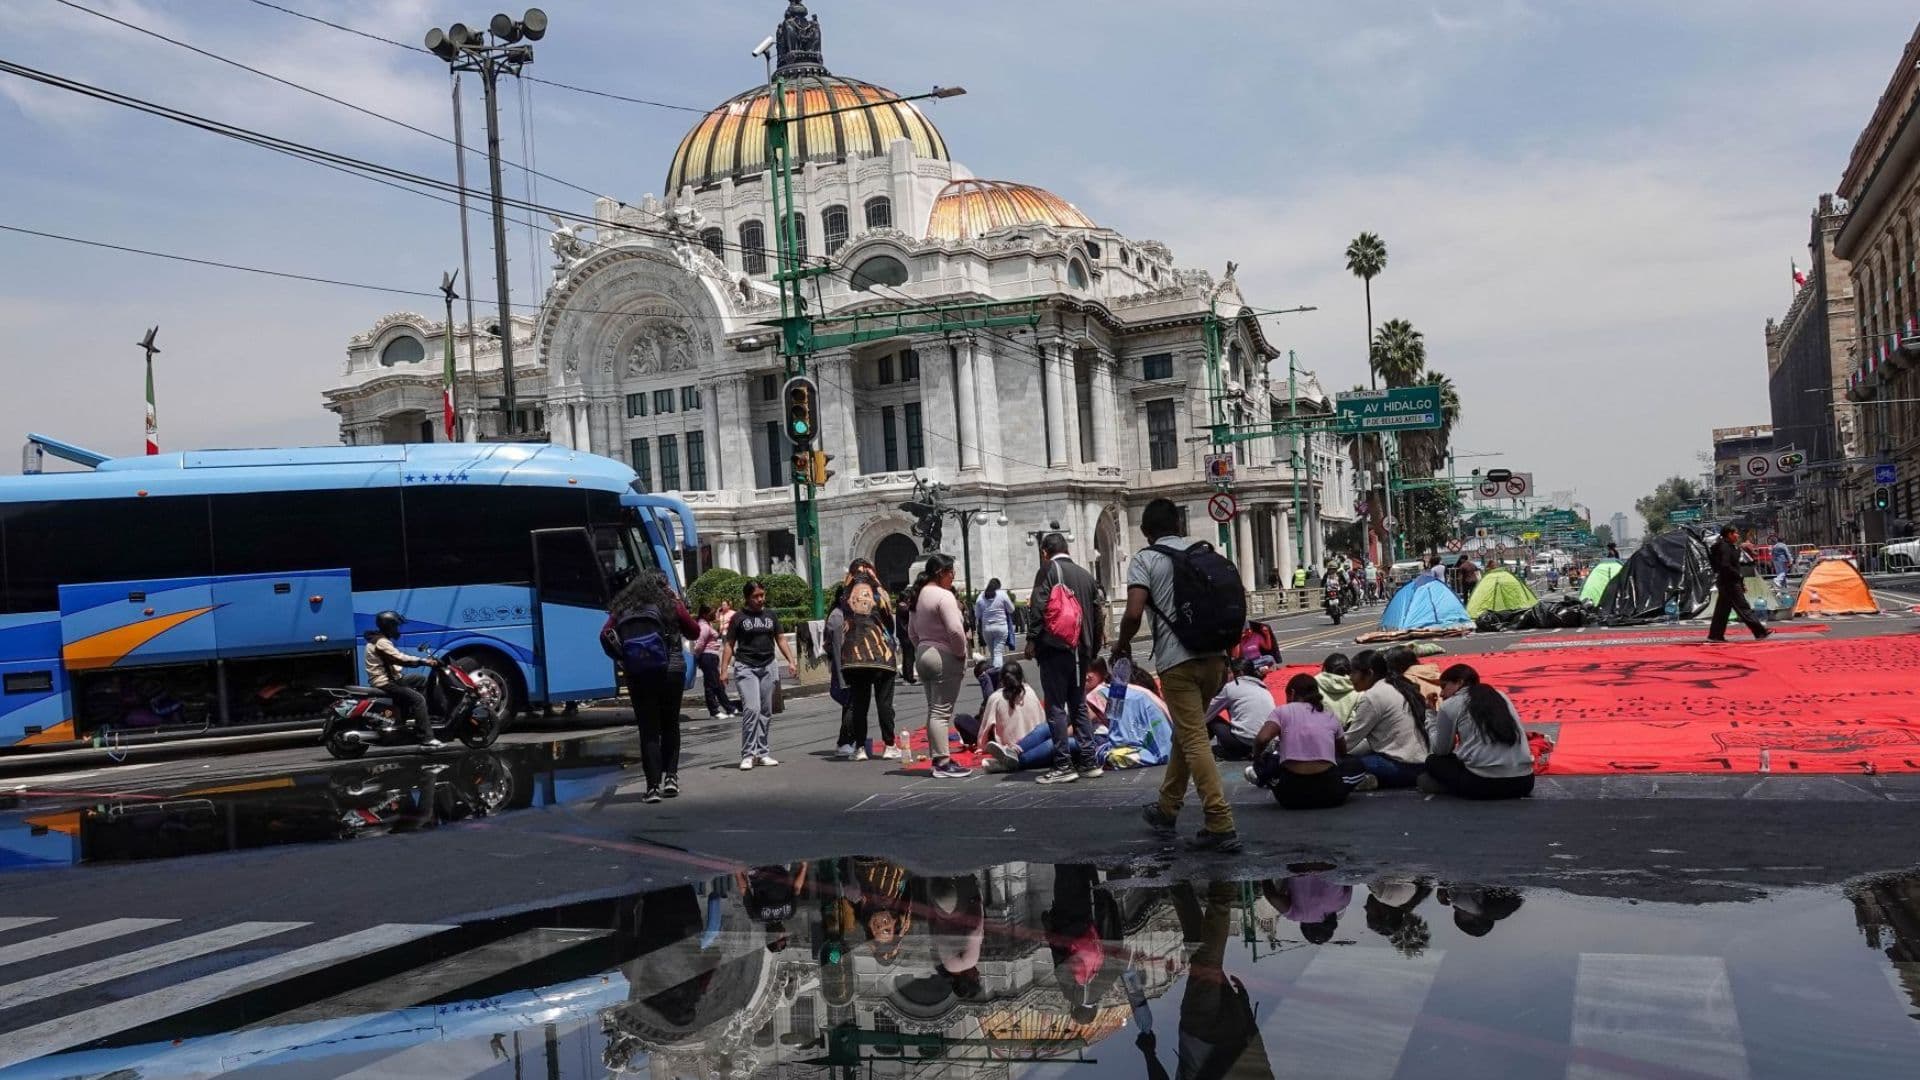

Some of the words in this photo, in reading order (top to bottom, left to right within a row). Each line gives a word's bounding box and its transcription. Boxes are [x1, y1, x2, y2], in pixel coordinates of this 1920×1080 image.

[1354, 390, 1384, 398] CENTRAL
[1363, 402, 1379, 413] AV
[1383, 399, 1433, 412] HIDALGO
